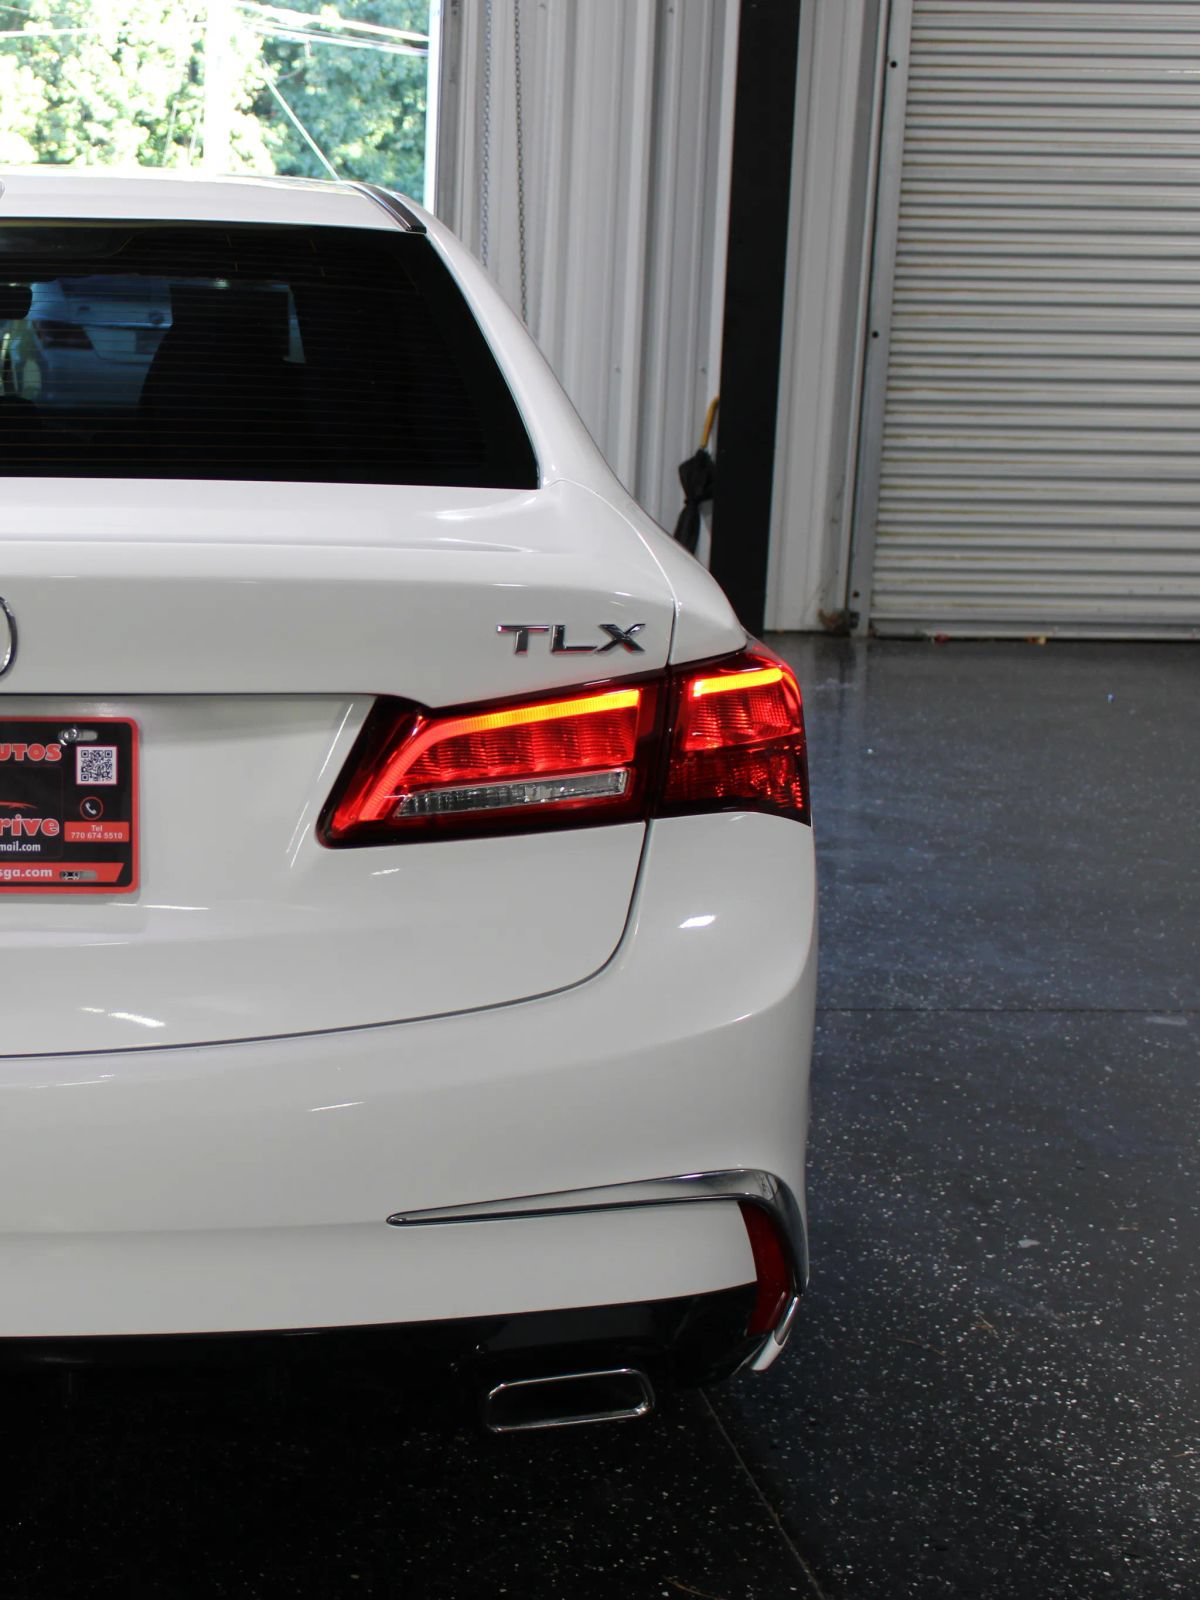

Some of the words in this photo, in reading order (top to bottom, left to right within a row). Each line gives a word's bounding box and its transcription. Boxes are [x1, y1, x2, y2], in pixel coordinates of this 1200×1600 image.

[497, 623, 646, 654] TLX
[91, 824, 103, 832] Tel
[71, 831, 85, 839] 770
[87, 831, 102, 839] 674
